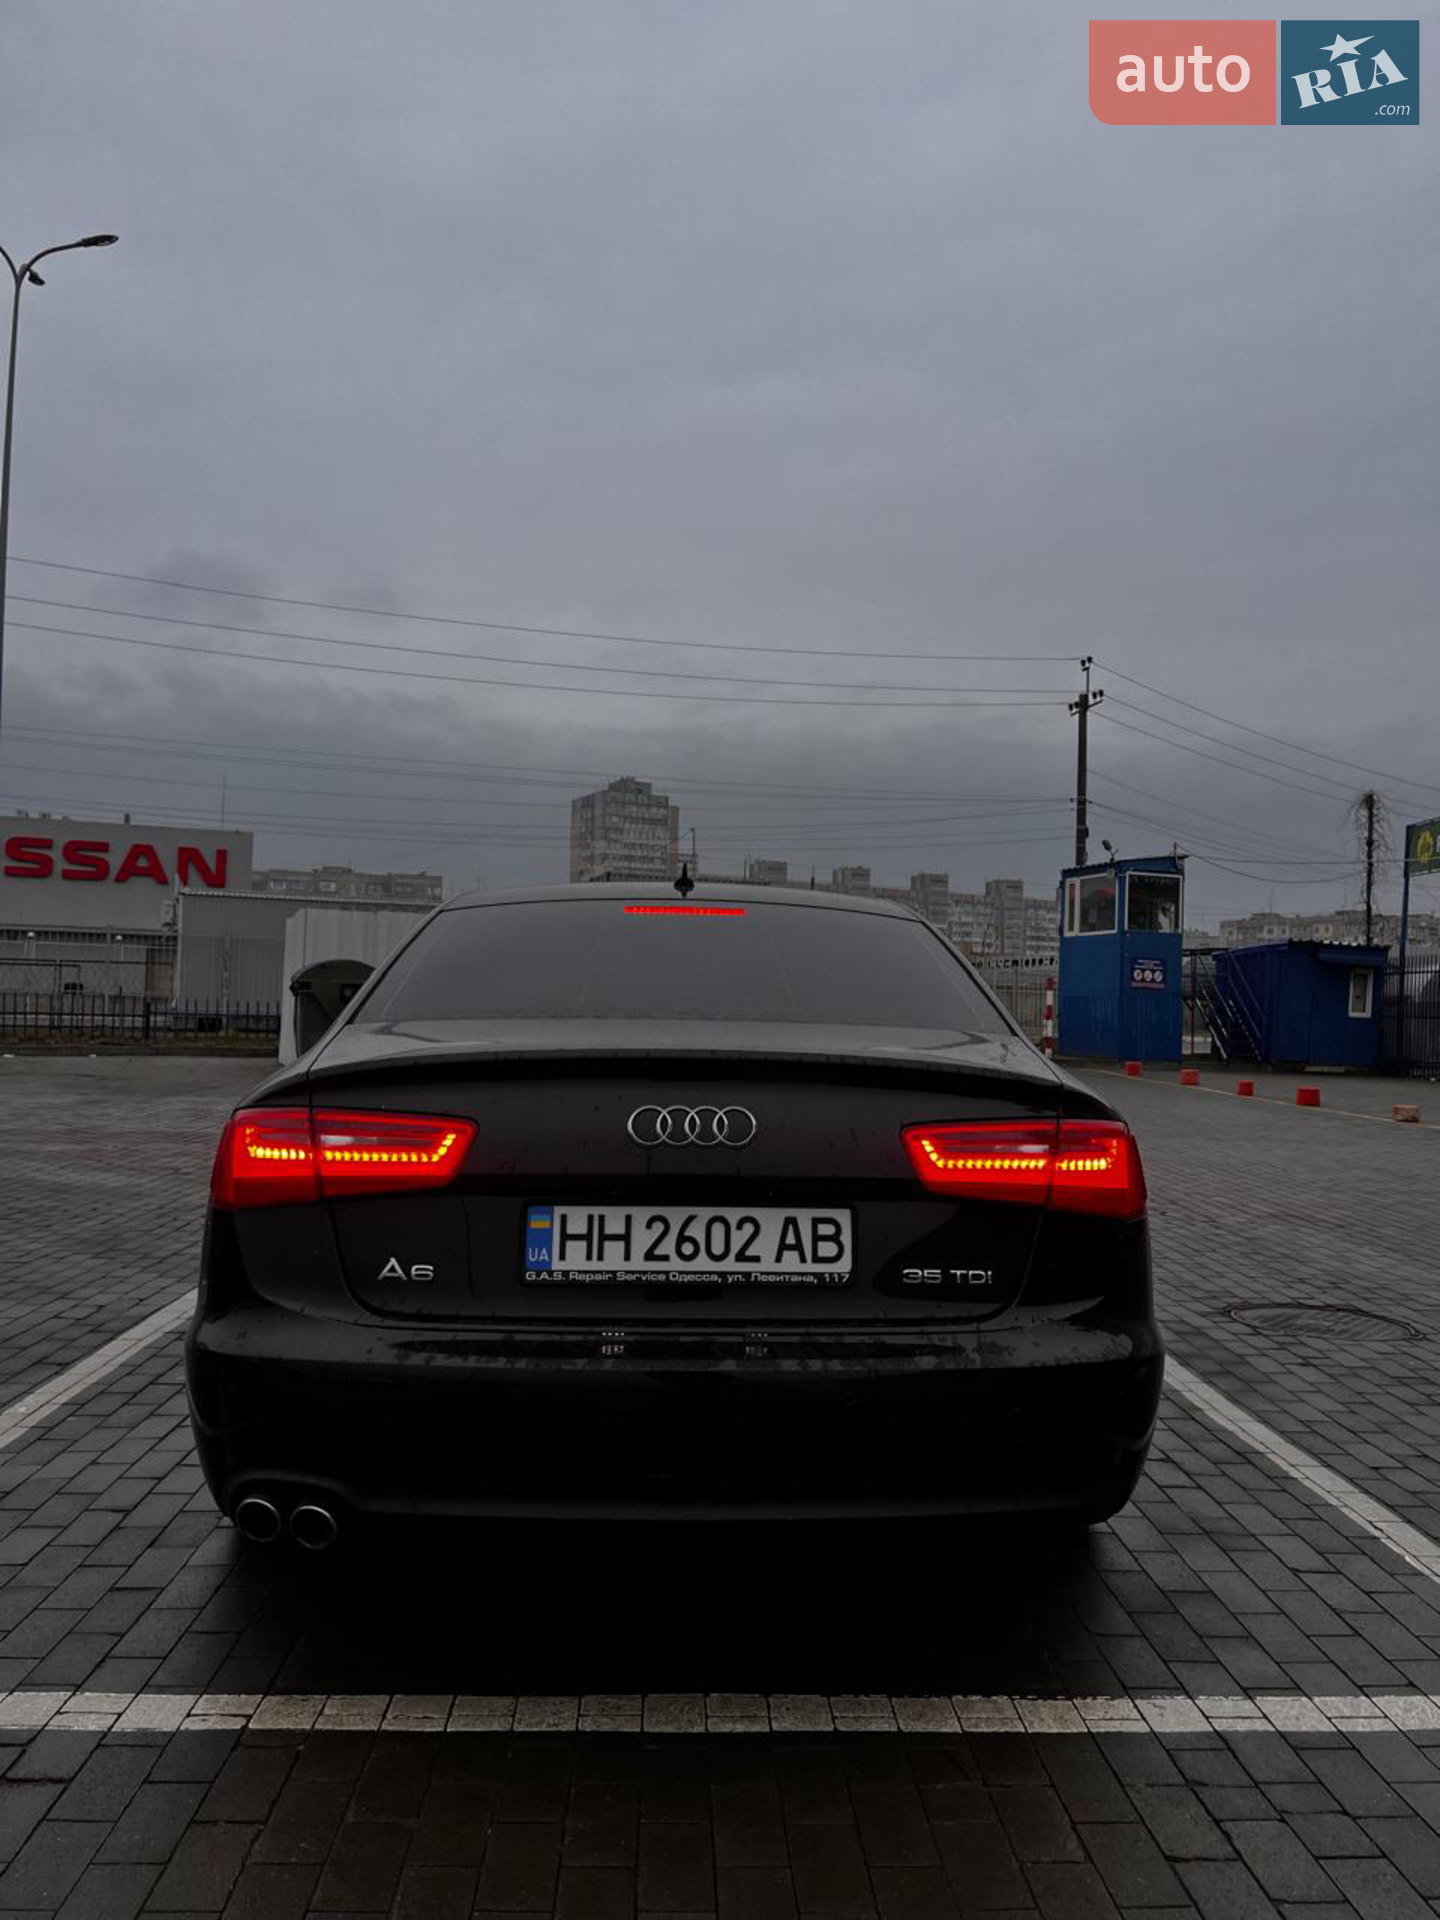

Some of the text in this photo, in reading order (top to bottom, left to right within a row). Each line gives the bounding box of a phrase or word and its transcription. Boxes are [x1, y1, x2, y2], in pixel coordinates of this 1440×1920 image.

[4, 836, 228, 889] SSAN
[559, 1214, 845, 1264] HH 2602 AB
[528, 1247, 550, 1262] UA
[376, 1256, 435, 1281] A6
[525, 1271, 566, 1282] G.A.S.
[568, 1271, 613, 1284] Repair
[615, 1271, 667, 1283] Service
[822, 1272, 851, 1284] 117
[902, 1268, 942, 1285] 35
